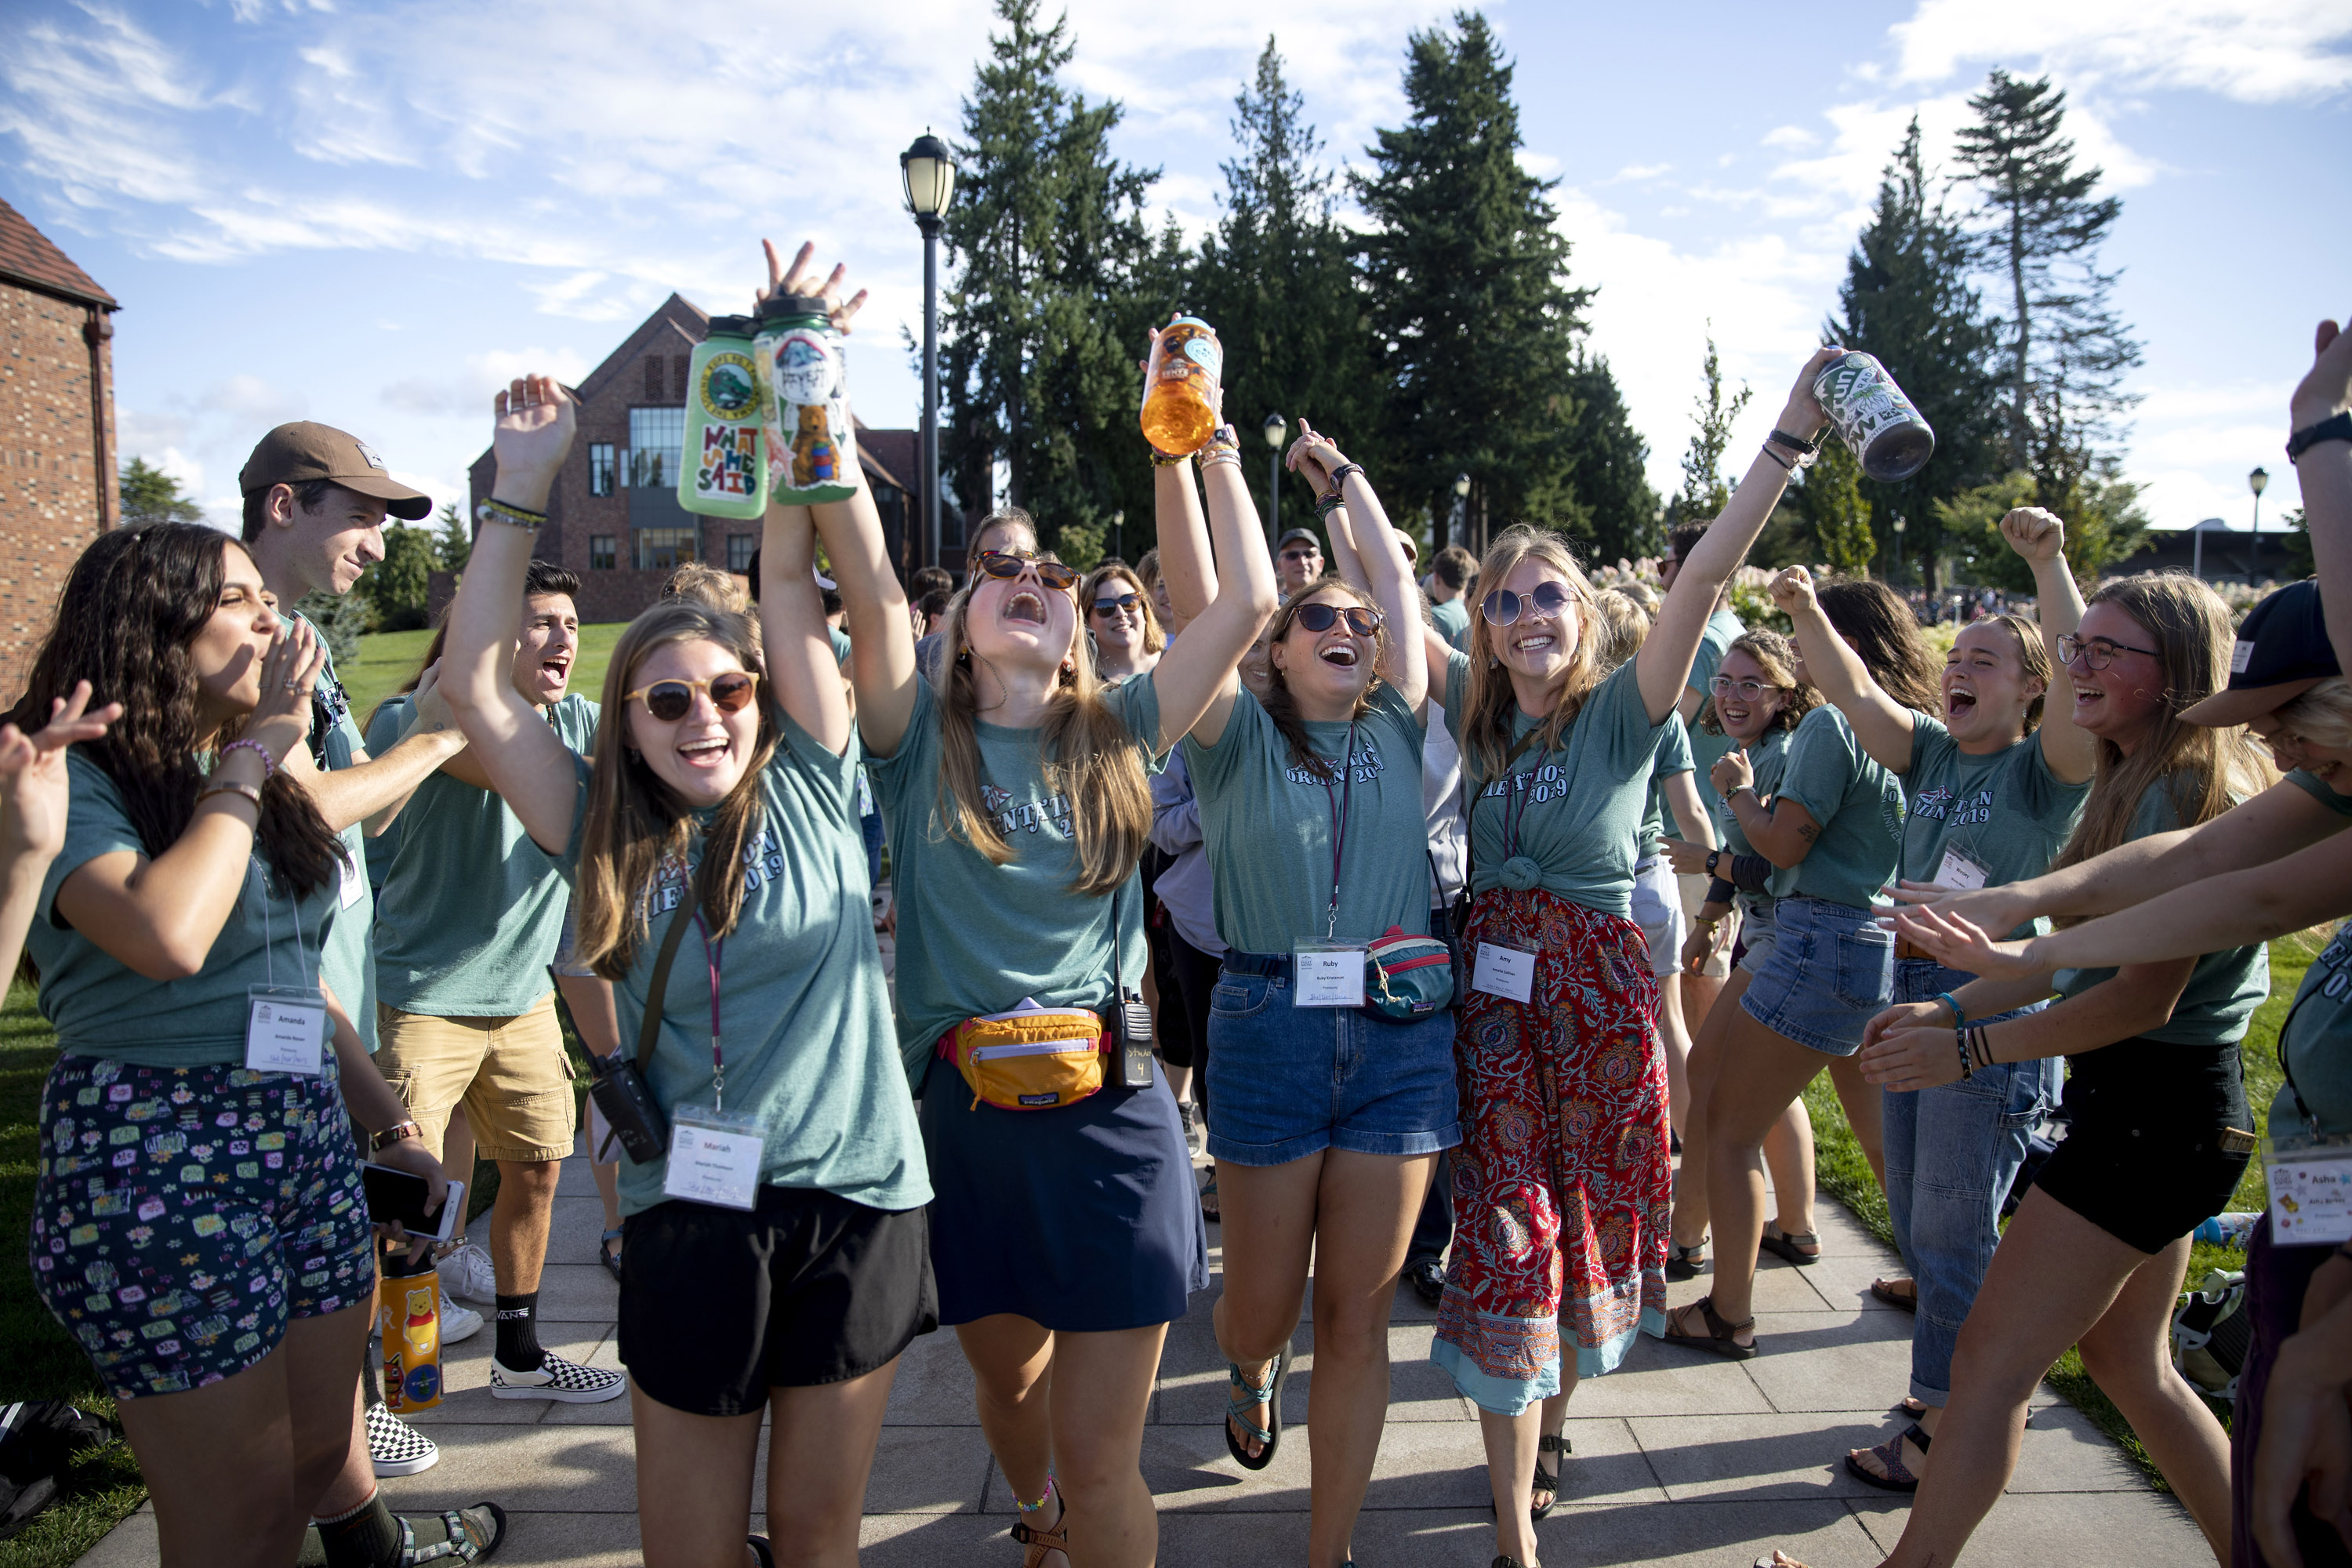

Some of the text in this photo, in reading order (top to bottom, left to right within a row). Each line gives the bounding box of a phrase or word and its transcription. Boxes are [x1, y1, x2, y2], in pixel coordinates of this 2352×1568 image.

[1832, 370, 1857, 411] run
[705, 425, 758, 457] WHAT
[702, 448, 756, 475] SHE
[697, 462, 757, 495] SAID
[278, 1015, 306, 1025] Amanda
[1138, 1062, 1144, 1076] 4
[704, 1142, 731, 1153] Mariah
[2312, 1176, 2336, 1185] Asha
[497, 1307, 529, 1320] VANS
